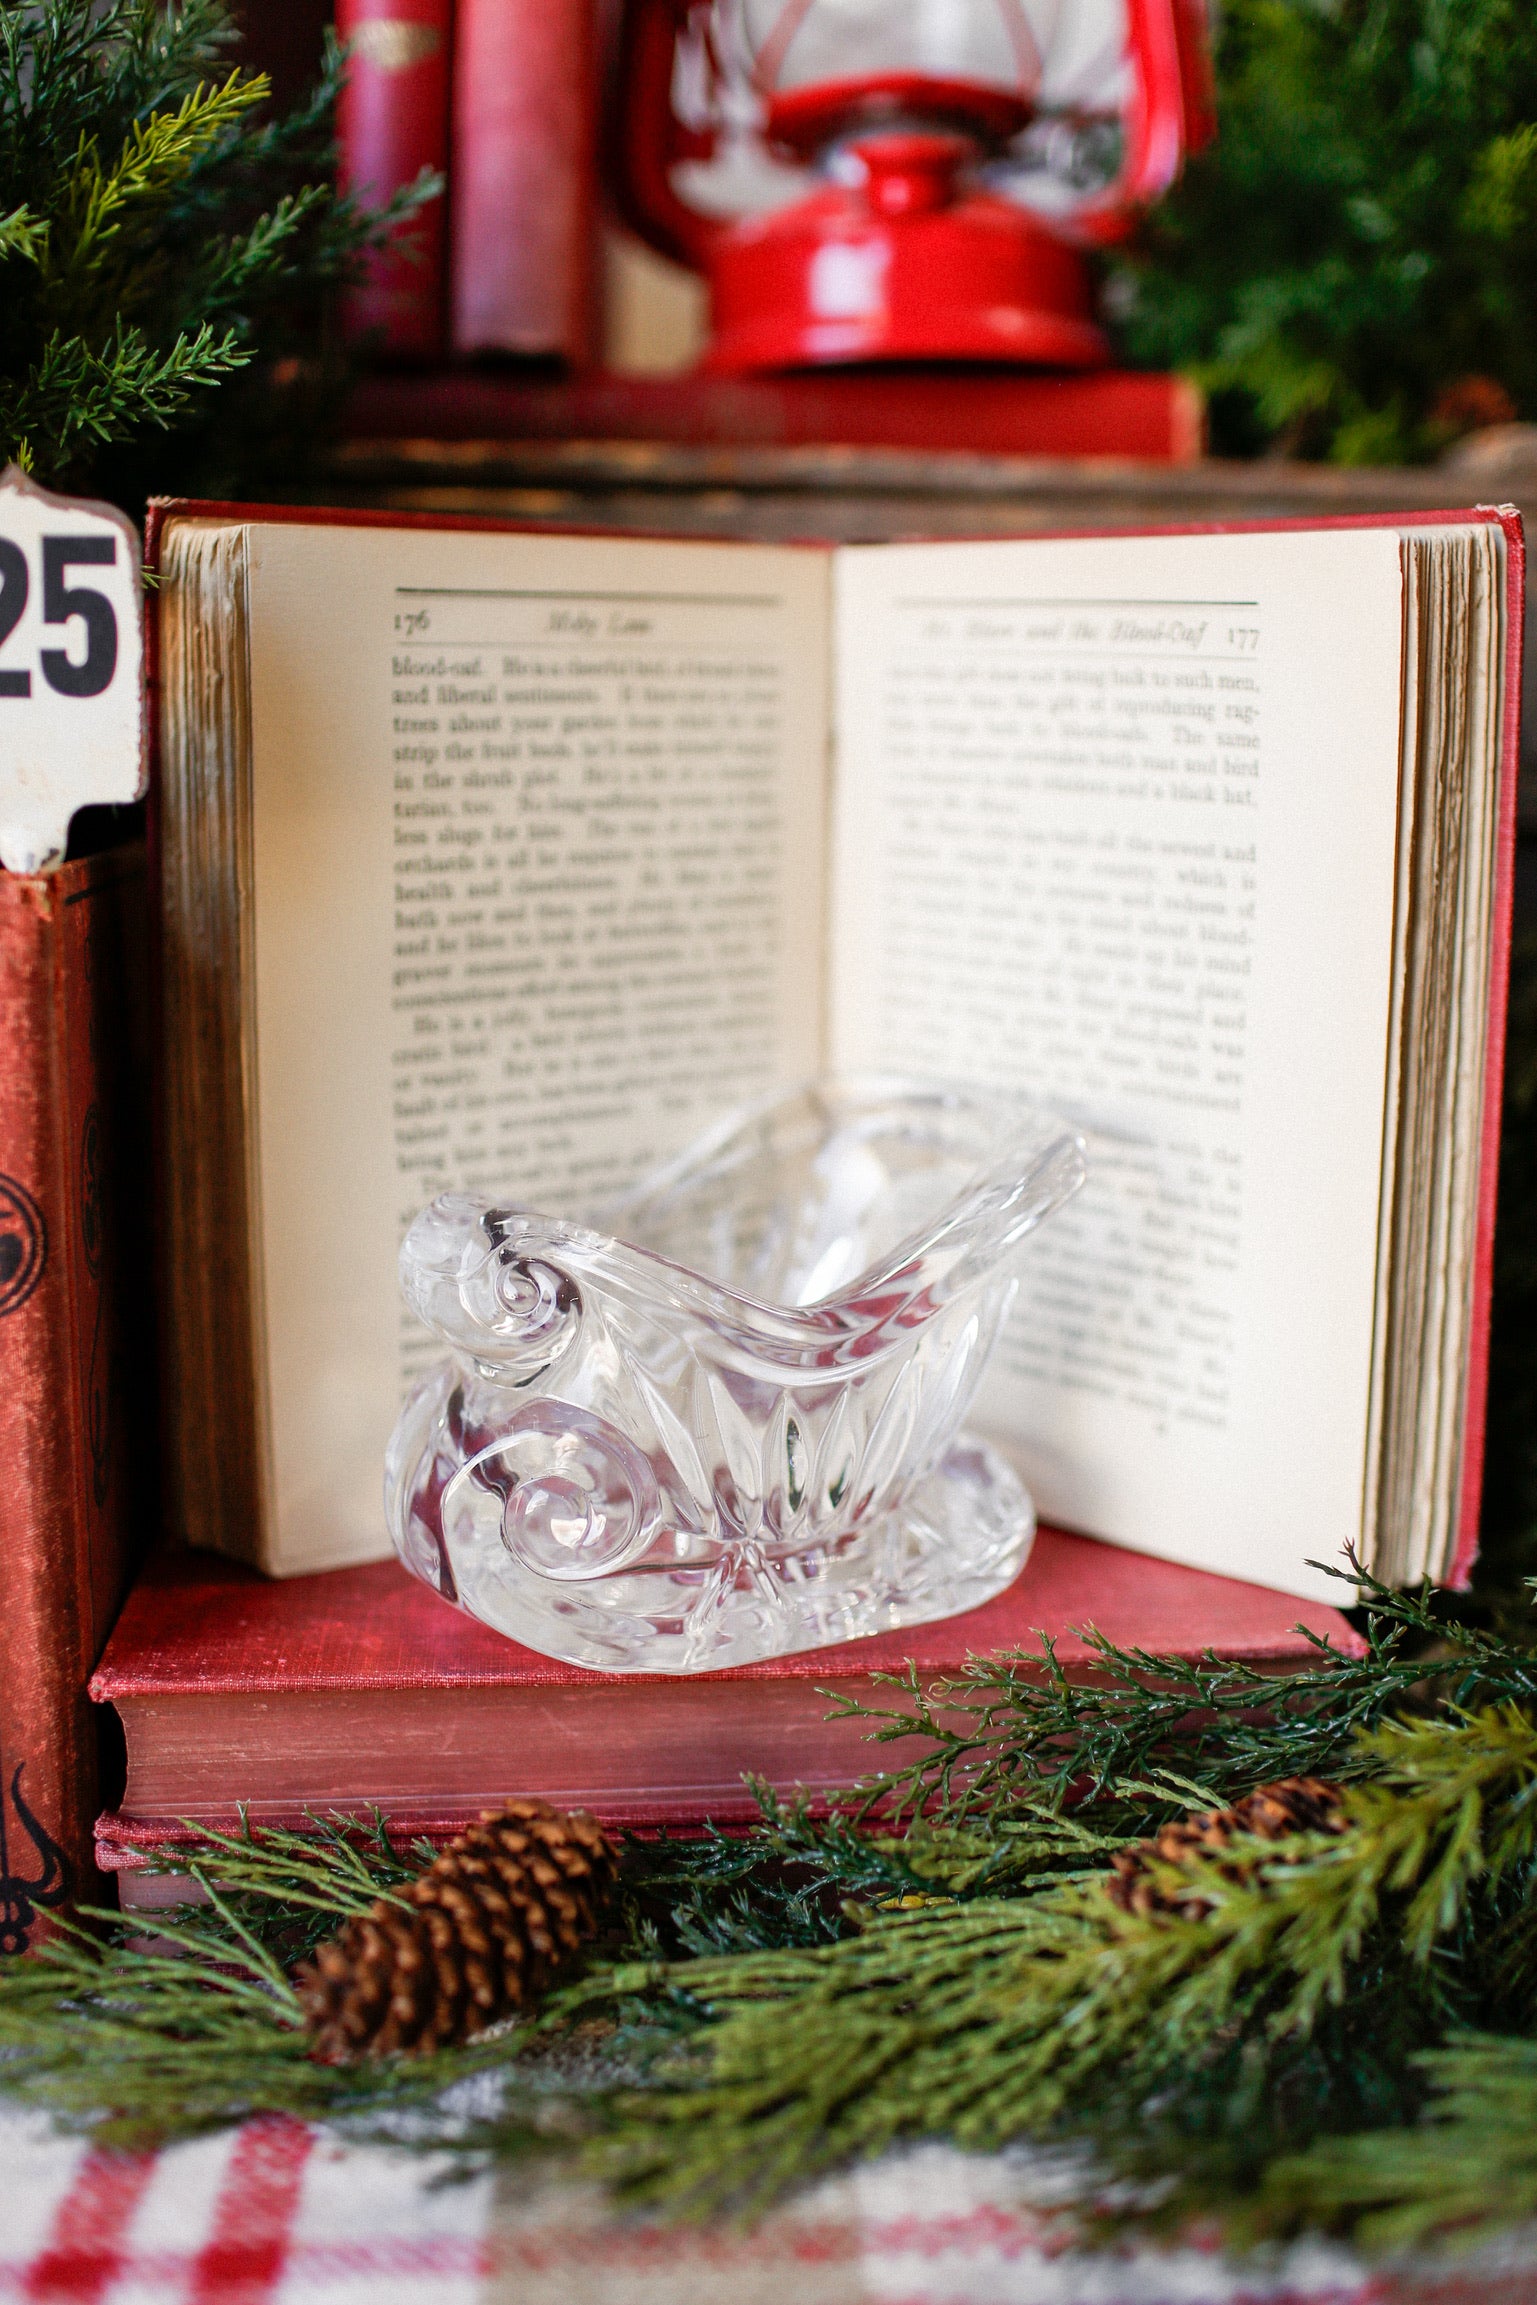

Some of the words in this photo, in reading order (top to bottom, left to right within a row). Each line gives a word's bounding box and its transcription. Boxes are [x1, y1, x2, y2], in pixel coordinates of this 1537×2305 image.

[393, 610, 430, 636] 176
[1228, 627, 1260, 649] 177
[1174, 669, 1213, 688] such
[392, 685, 430, 703] and
